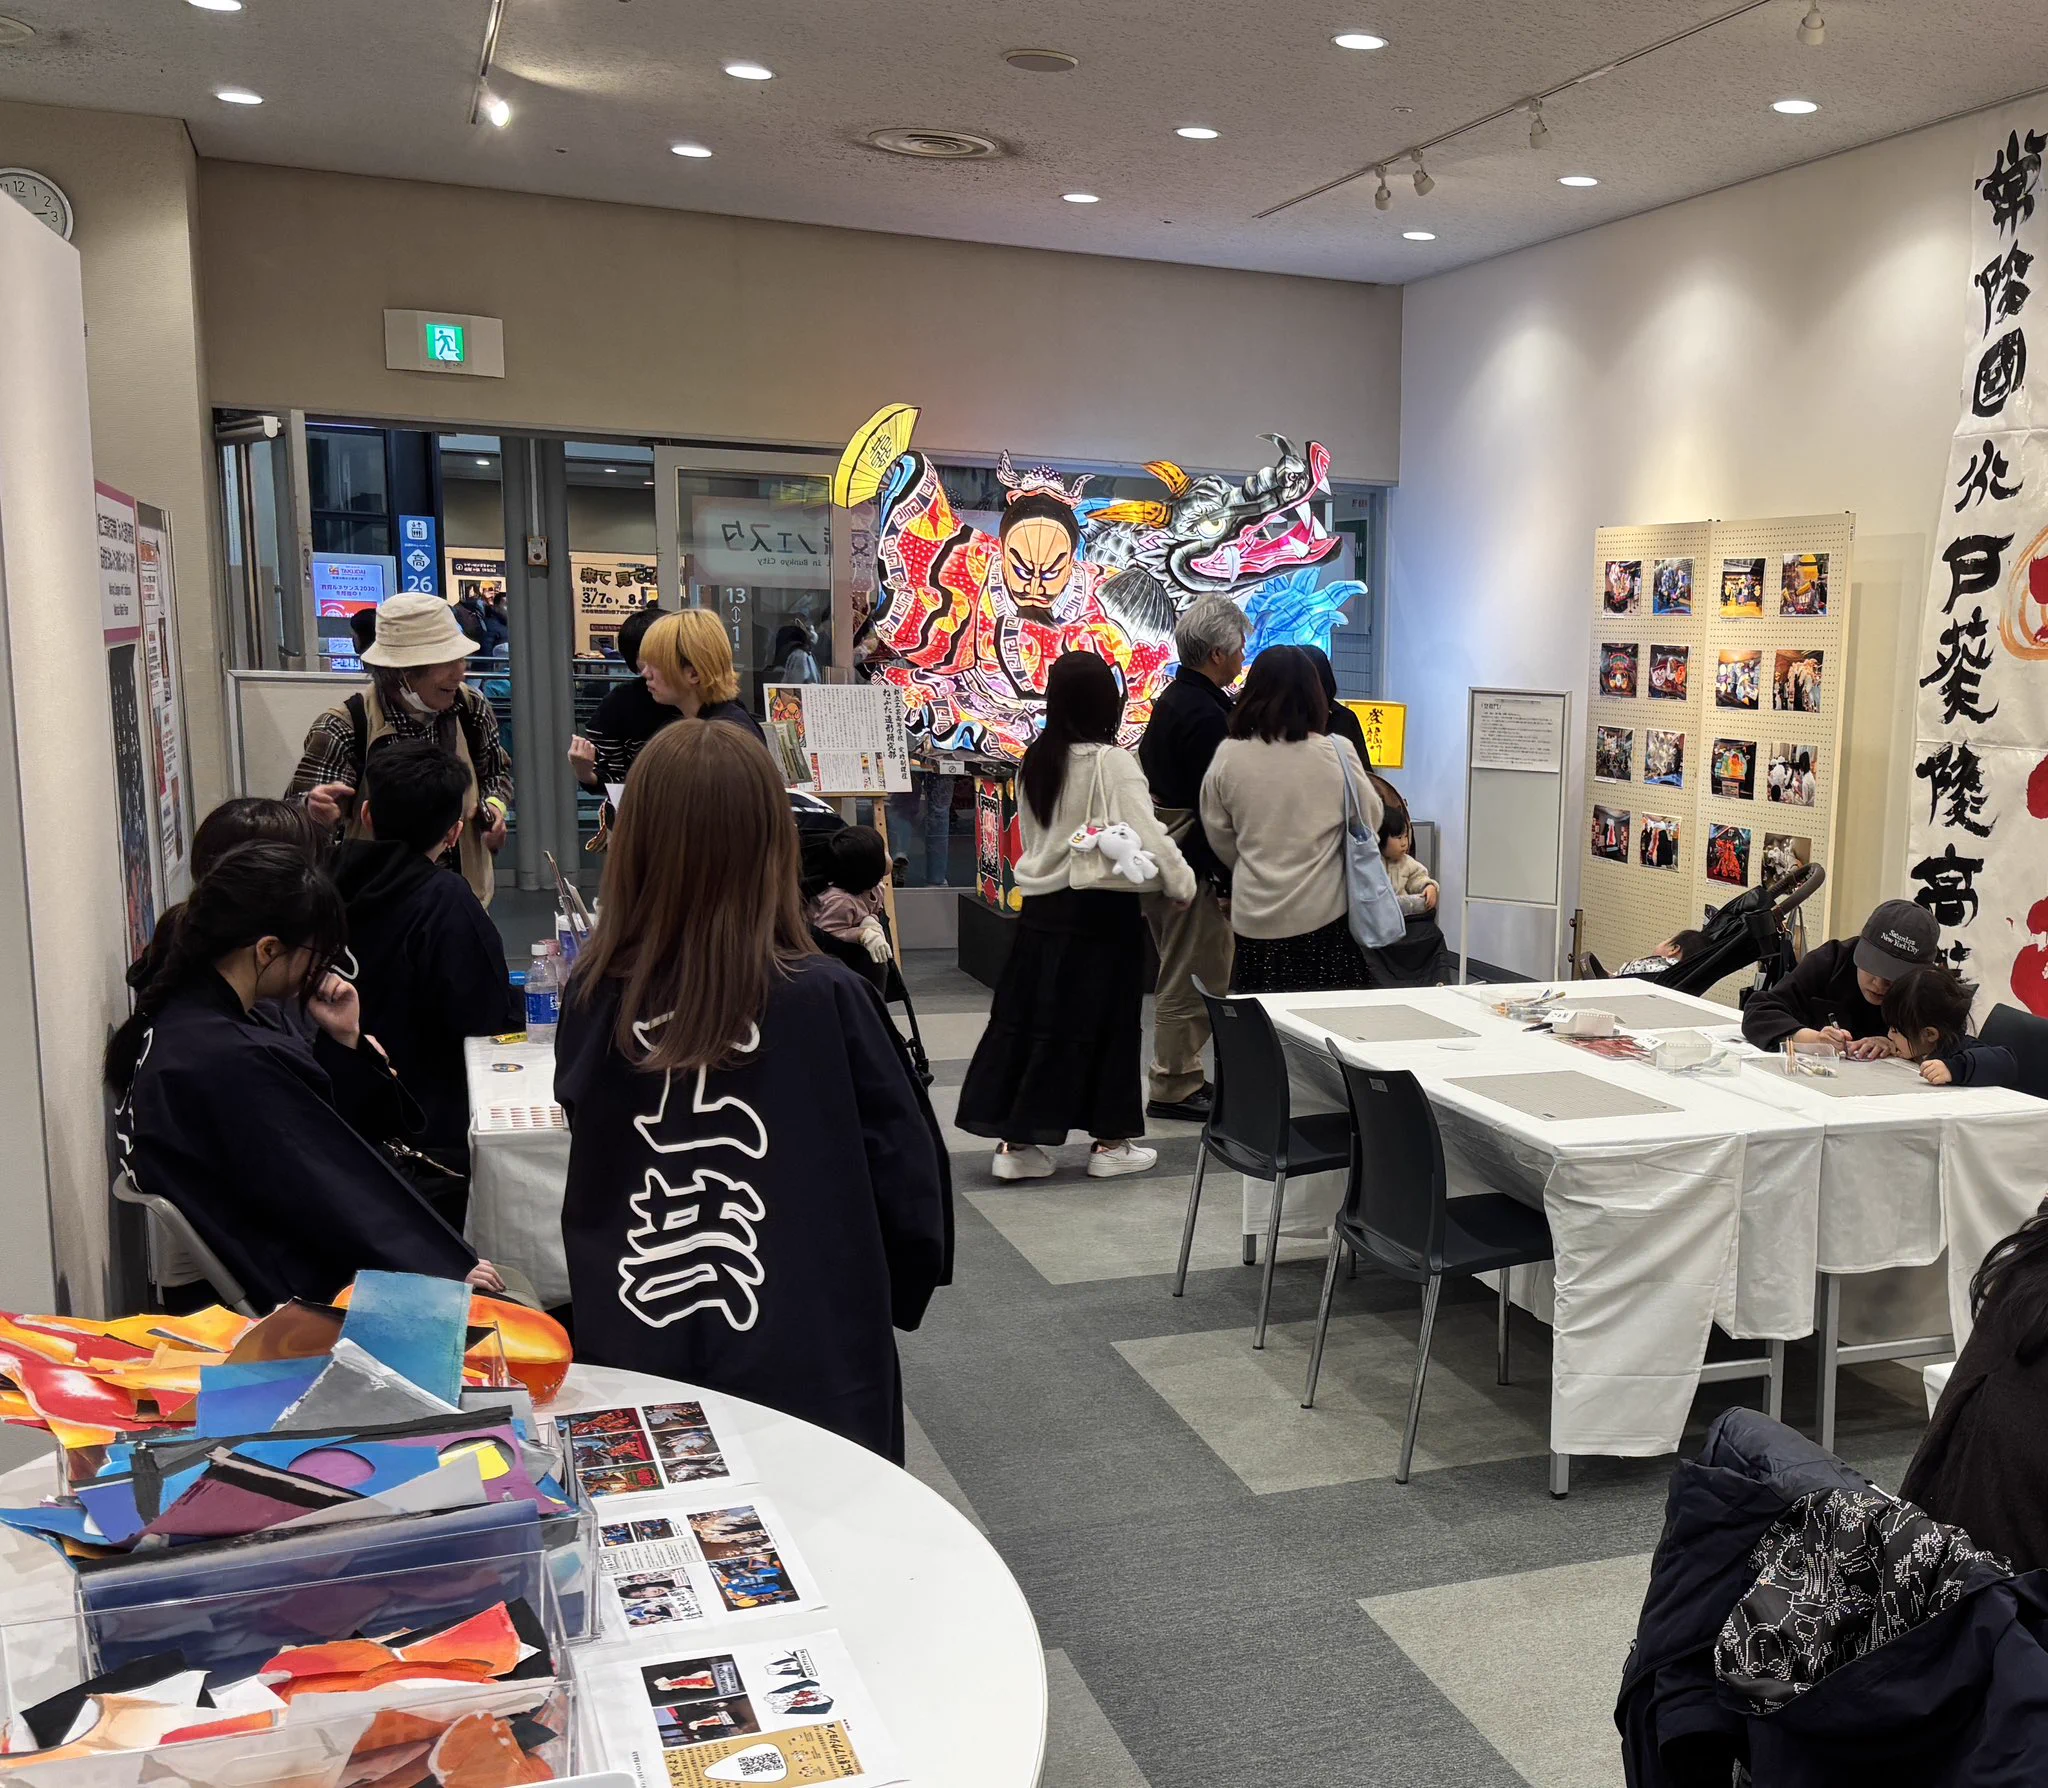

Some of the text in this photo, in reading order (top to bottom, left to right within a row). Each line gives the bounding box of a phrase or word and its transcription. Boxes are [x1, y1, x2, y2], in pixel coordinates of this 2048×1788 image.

[13, 181, 25, 192] 12
[33, 186, 37, 197] 1
[44, 195, 51, 207] 2
[50, 211, 58, 222] 3
[412, 554, 425, 567] 高
[408, 576, 432, 592] 26
[726, 587, 746, 604] 13
[732, 625, 740, 642] 1
[1881, 932, 1920, 955] New York City
